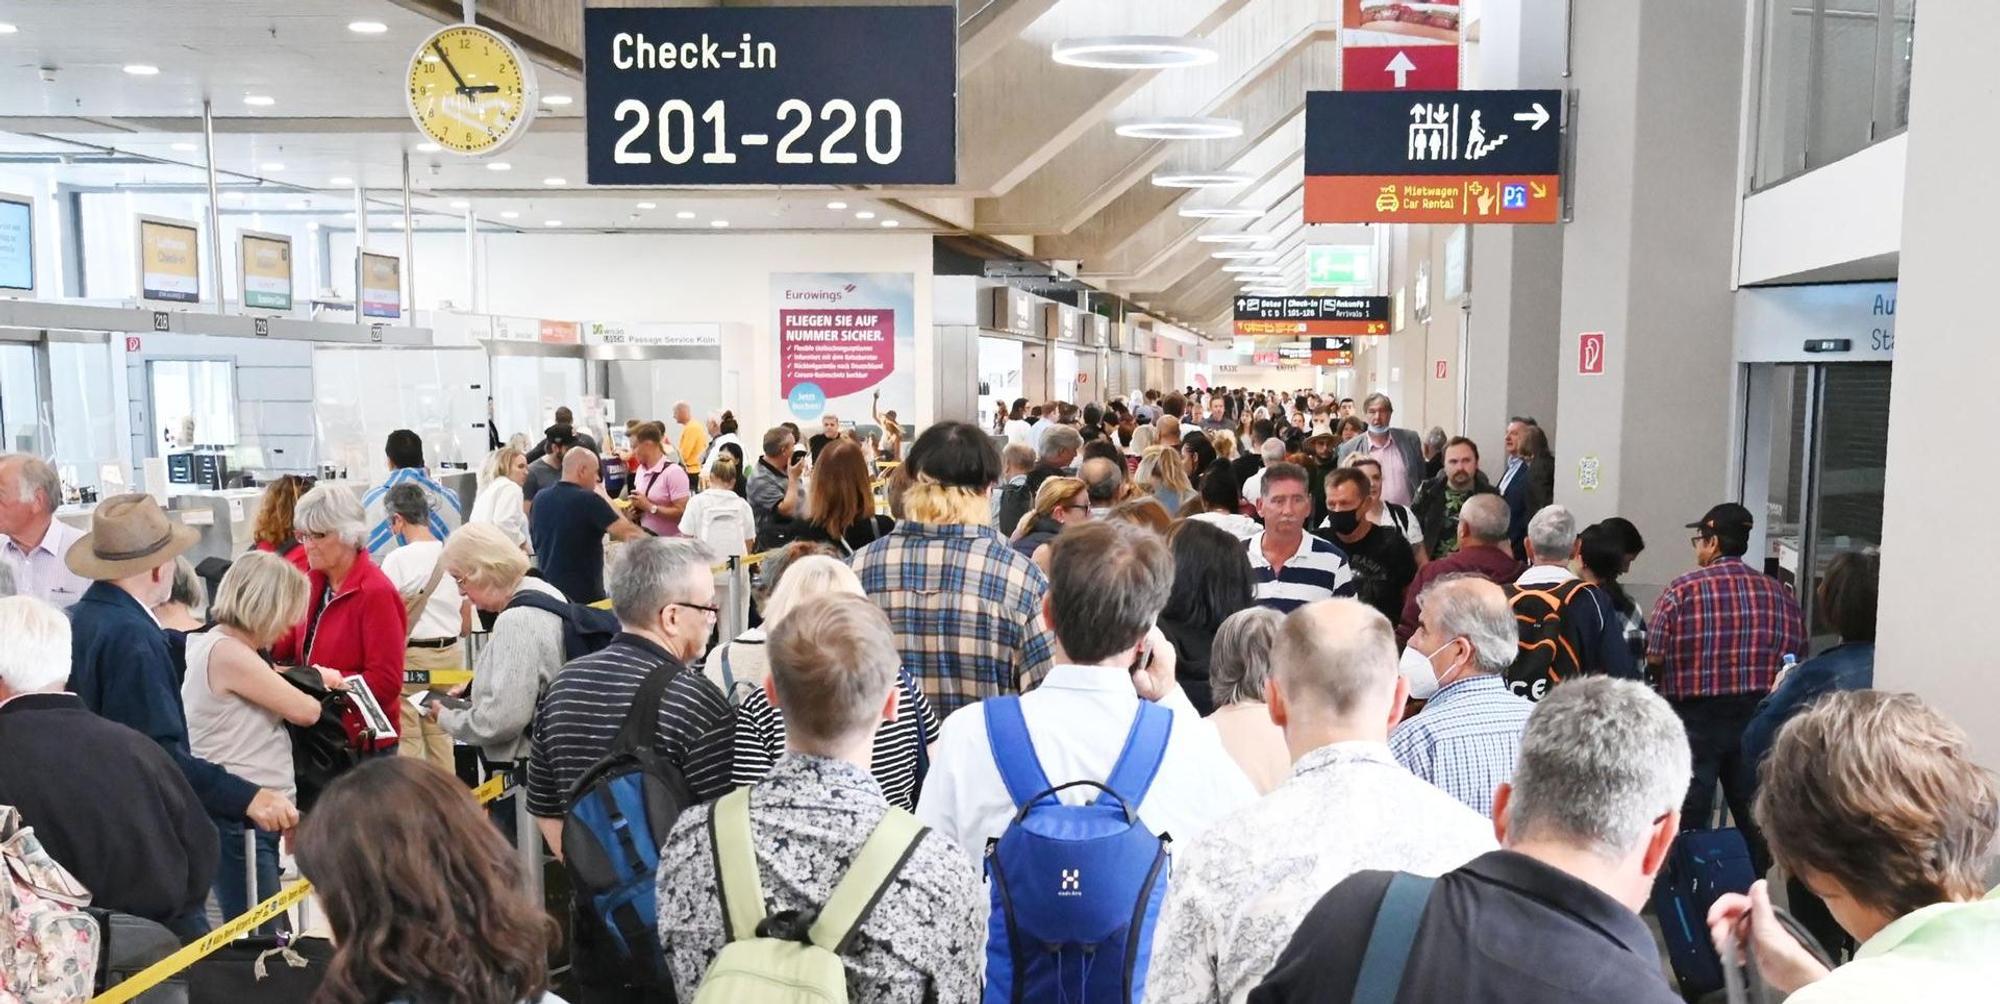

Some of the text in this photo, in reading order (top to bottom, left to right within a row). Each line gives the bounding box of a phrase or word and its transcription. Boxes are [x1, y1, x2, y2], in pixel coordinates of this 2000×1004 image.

[460, 39, 471, 49] 12
[485, 47, 489, 56] 1
[613, 32, 777, 70] Check-in
[424, 64, 505, 74] 10 2
[420, 86, 513, 96] 9 3
[443, 127, 494, 137] 7 5
[614, 98, 902, 165] 201-220
[466, 133, 472, 142] 6
[1404, 186, 1458, 198] Mietwagen
[1403, 199, 1454, 209] Car Rental
[785, 290, 842, 303] Eurowings
[1287, 299, 1318, 307] Check-in
[155, 314, 168, 330] 218
[786, 315, 878, 326] FLIEGEN SIE AUF
[786, 330, 884, 341] NUMMER SICHER.
